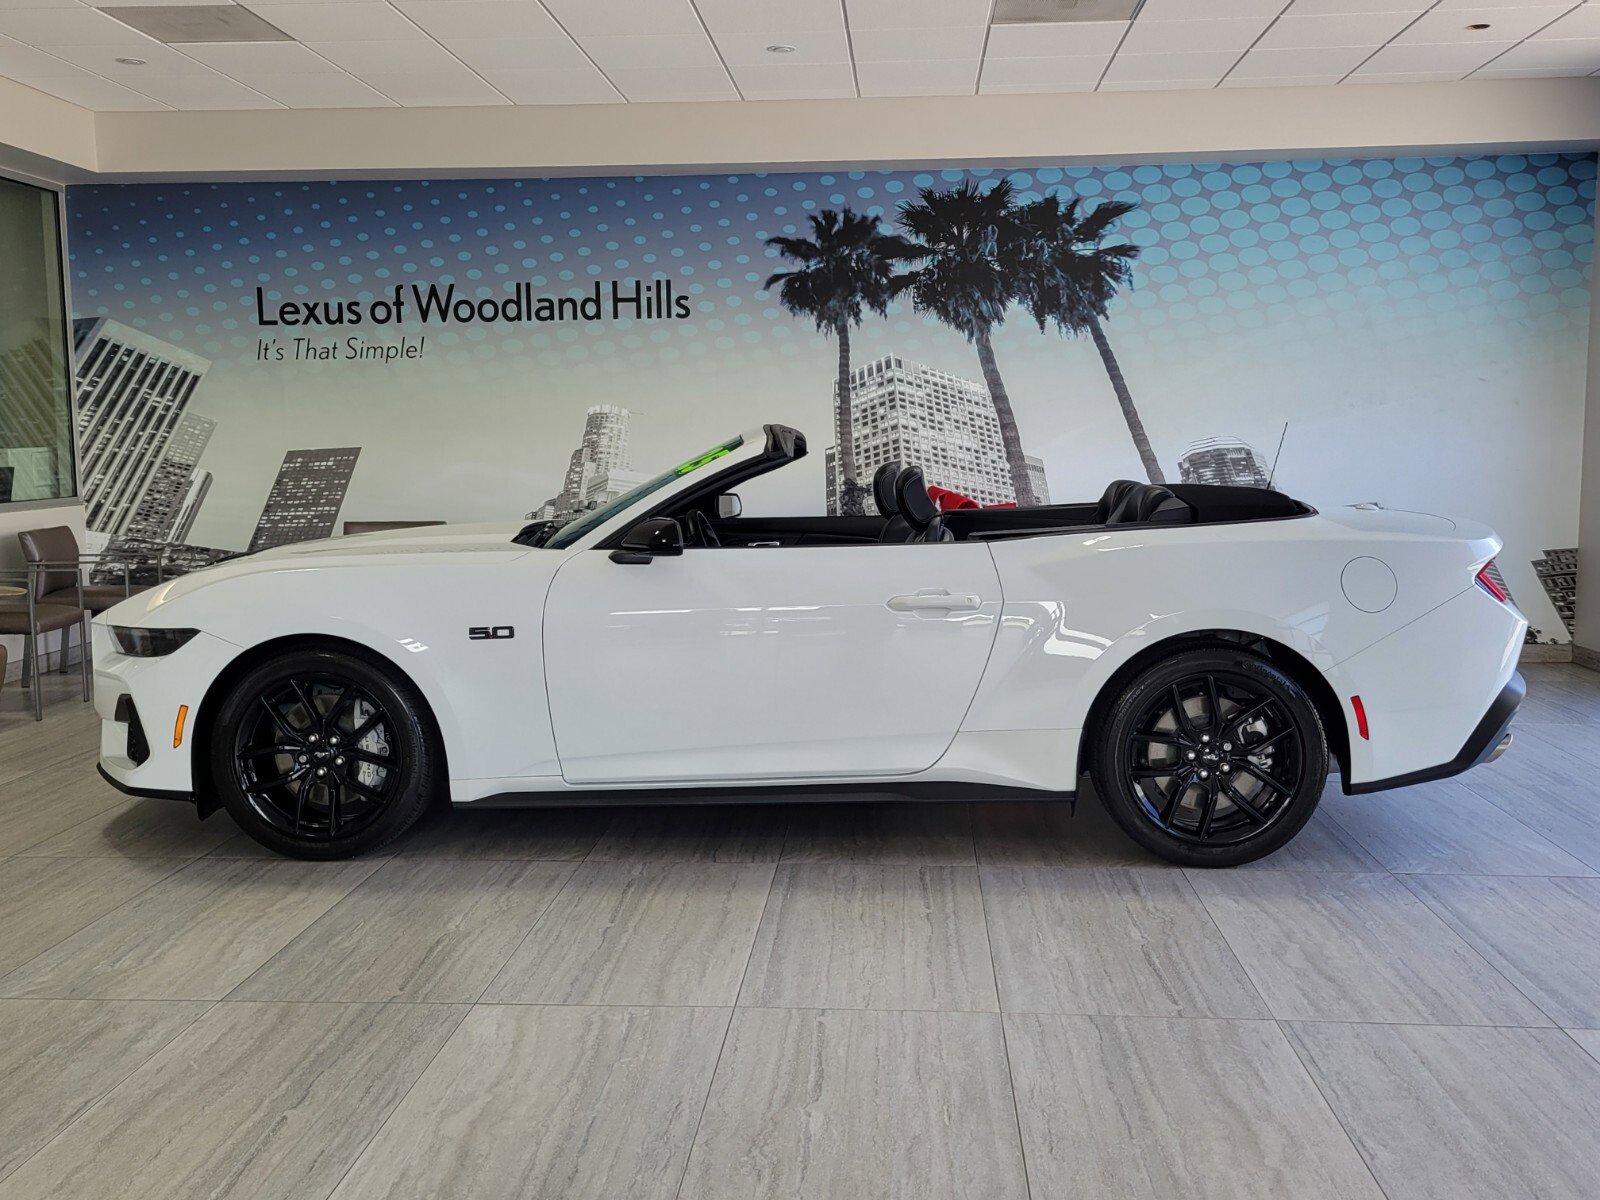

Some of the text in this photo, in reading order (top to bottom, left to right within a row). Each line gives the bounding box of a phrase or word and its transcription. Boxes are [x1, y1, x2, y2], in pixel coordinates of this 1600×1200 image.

[256, 279, 691, 326] Lexus of Woodland Hills
[256, 335, 426, 364] It's That Simple!
